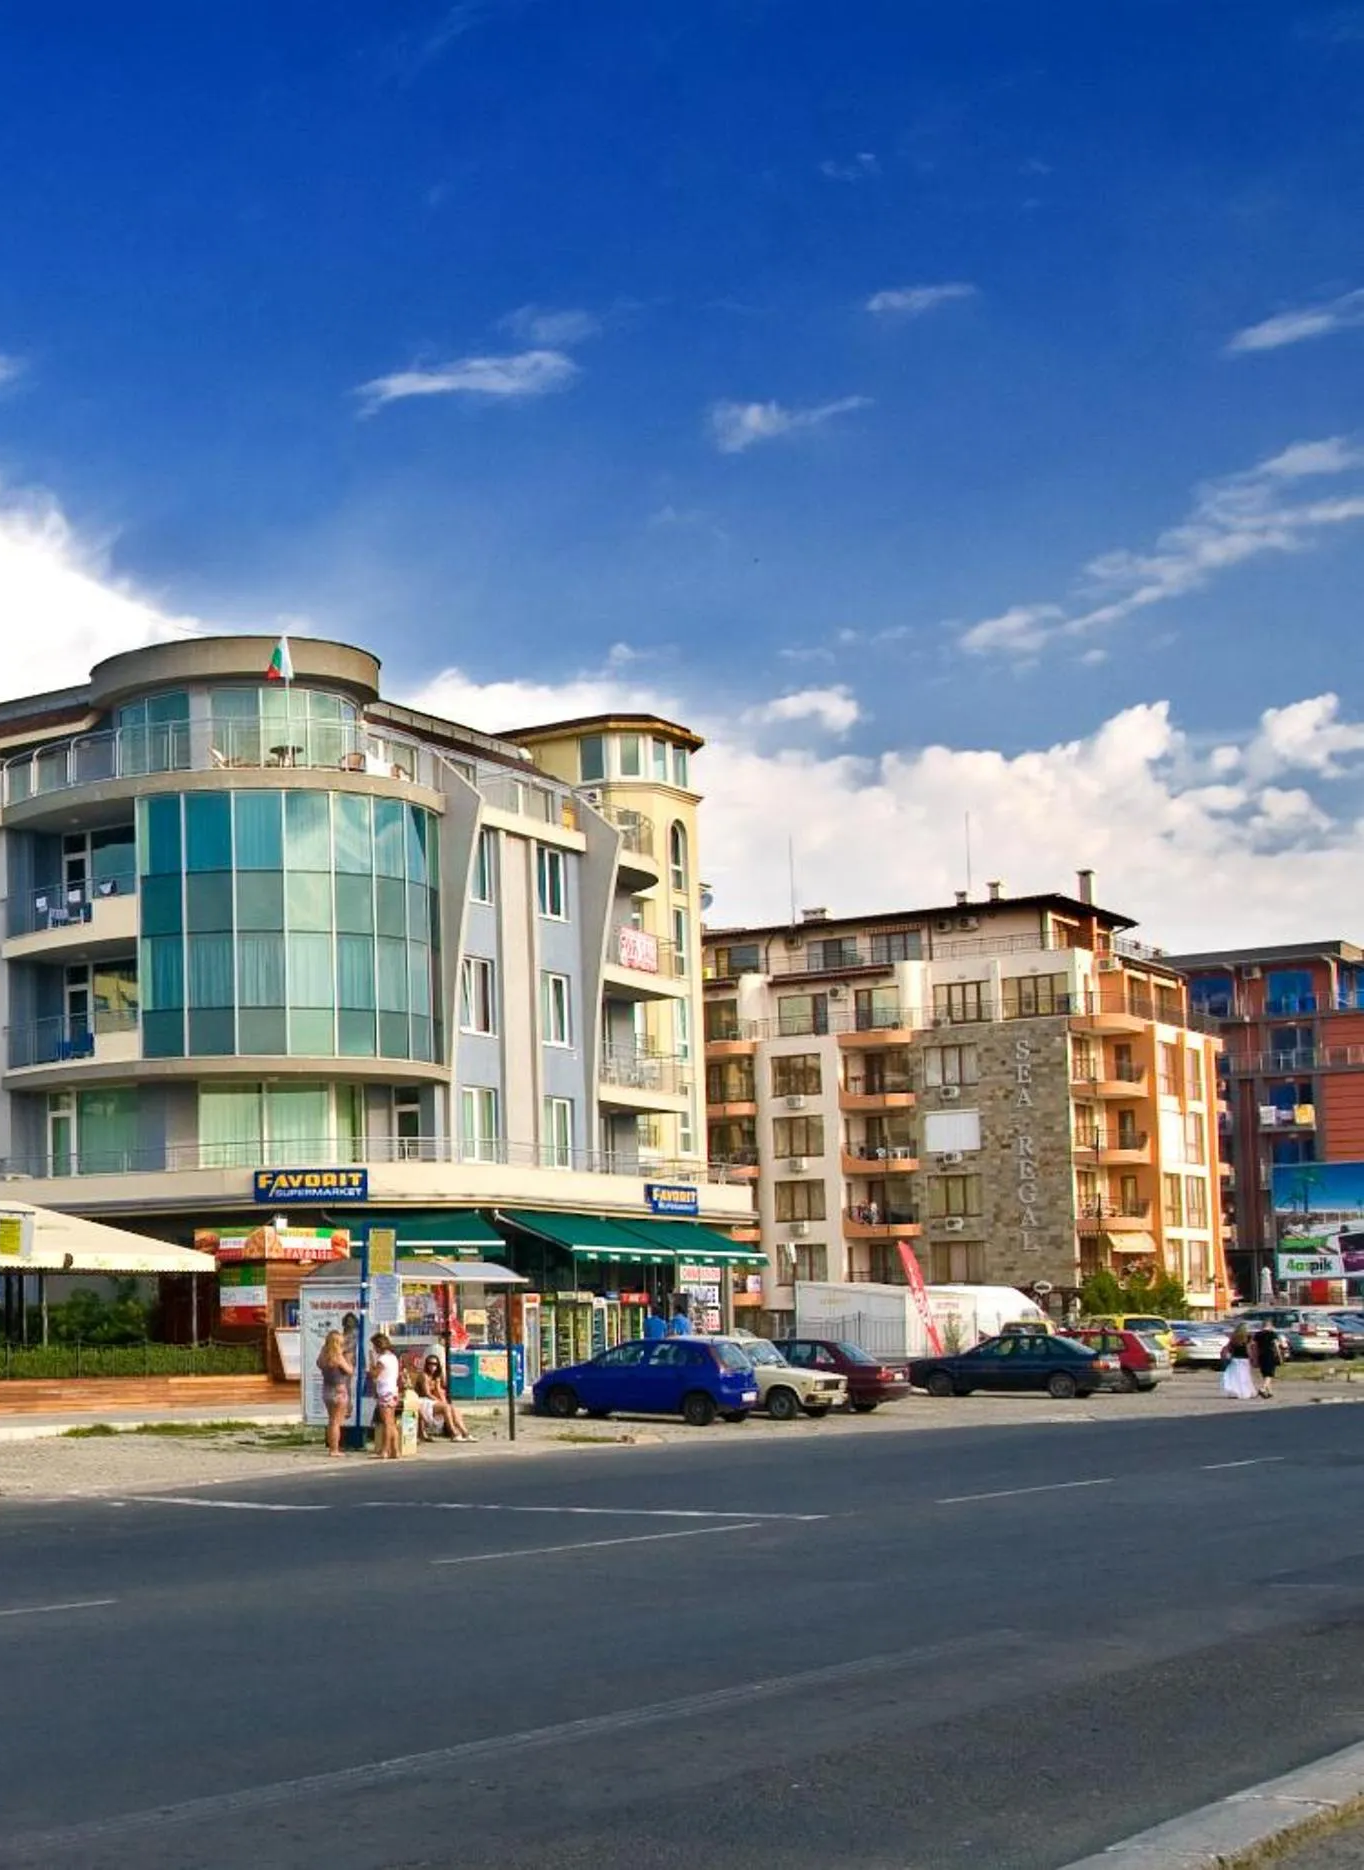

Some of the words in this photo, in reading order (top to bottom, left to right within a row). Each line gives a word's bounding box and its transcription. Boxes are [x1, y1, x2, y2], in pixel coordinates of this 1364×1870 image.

[1016, 1040, 1033, 1107] SEA
[258, 1173, 363, 1190] FAVORIT
[274, 1187, 363, 1198] SUPERMARKET
[1018, 1136, 1040, 1251] REGAL
